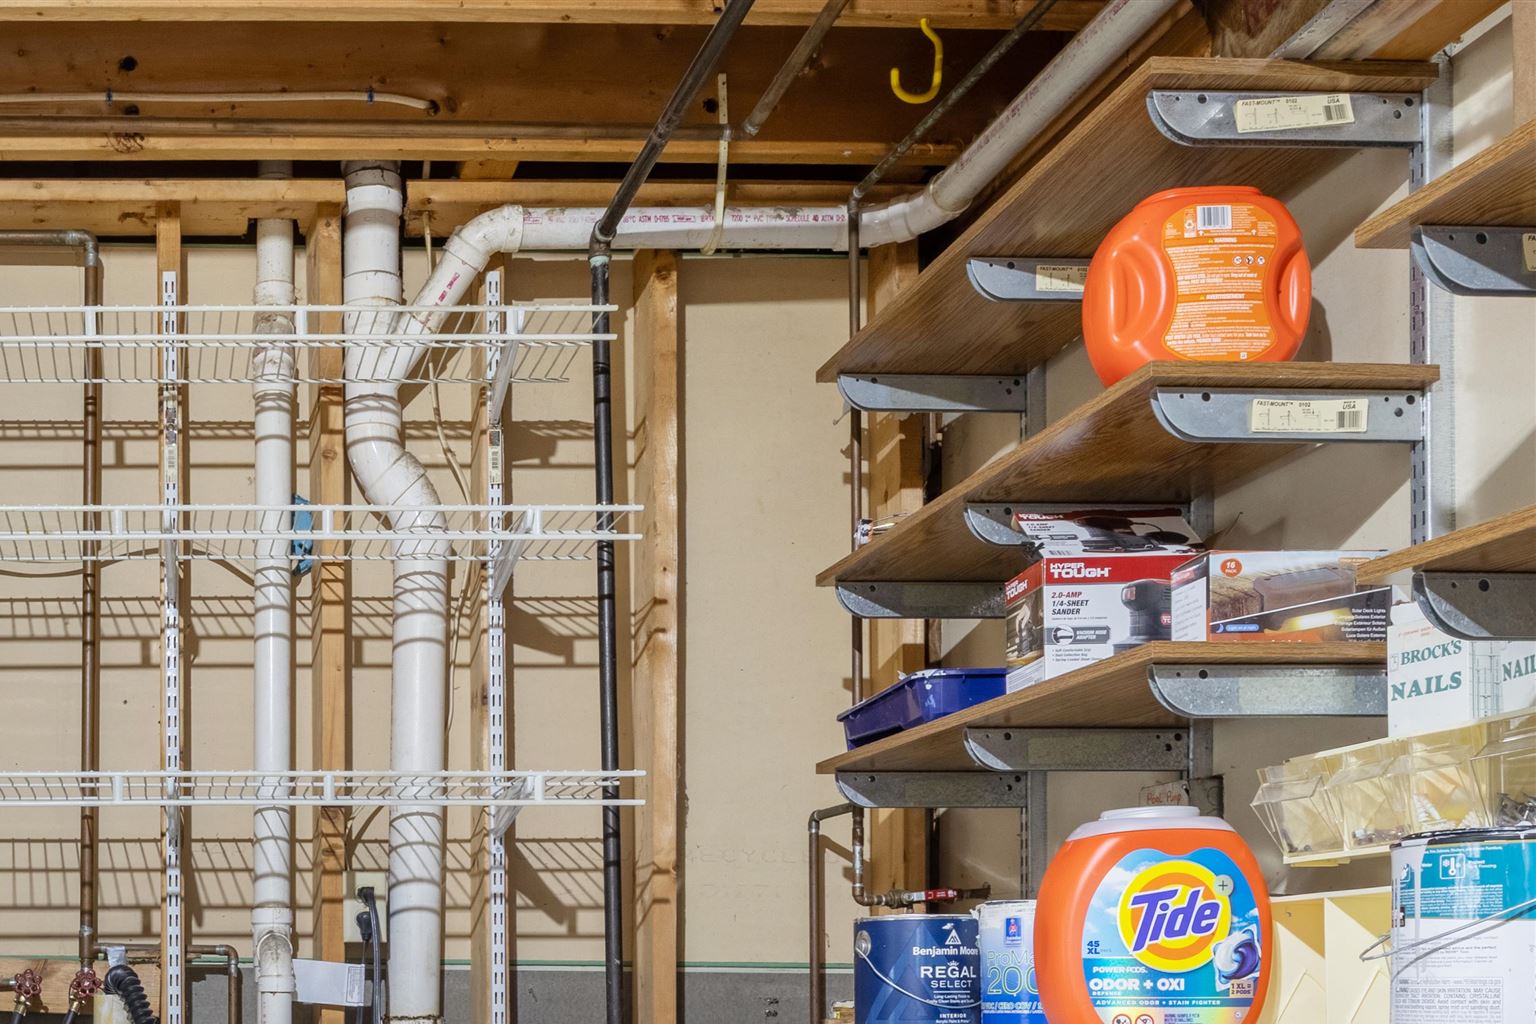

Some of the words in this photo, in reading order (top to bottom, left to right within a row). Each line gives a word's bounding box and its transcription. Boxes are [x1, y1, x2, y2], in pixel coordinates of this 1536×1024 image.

[1226, 561, 1236, 569] 16
[1006, 579, 1028, 600] TOUGH
[1051, 591, 1083, 599] 2.0-AMP
[1052, 599, 1090, 607] 1/4-SHEET
[1400, 639, 1463, 666] BROCK'S
[1502, 653, 1536, 682] NAIL
[1390, 670, 1462, 701] NAILS
[1128, 886, 1222, 952] Tide
[1087, 940, 1100, 948] 45
[912, 946, 958, 957] Benjamin
[959, 946, 979, 956] Moore
[920, 966, 977, 978] REGAL
[930, 980, 973, 988] SELECT
[1089, 978, 1140, 991] ODOR
[1157, 978, 1185, 991] OXI
